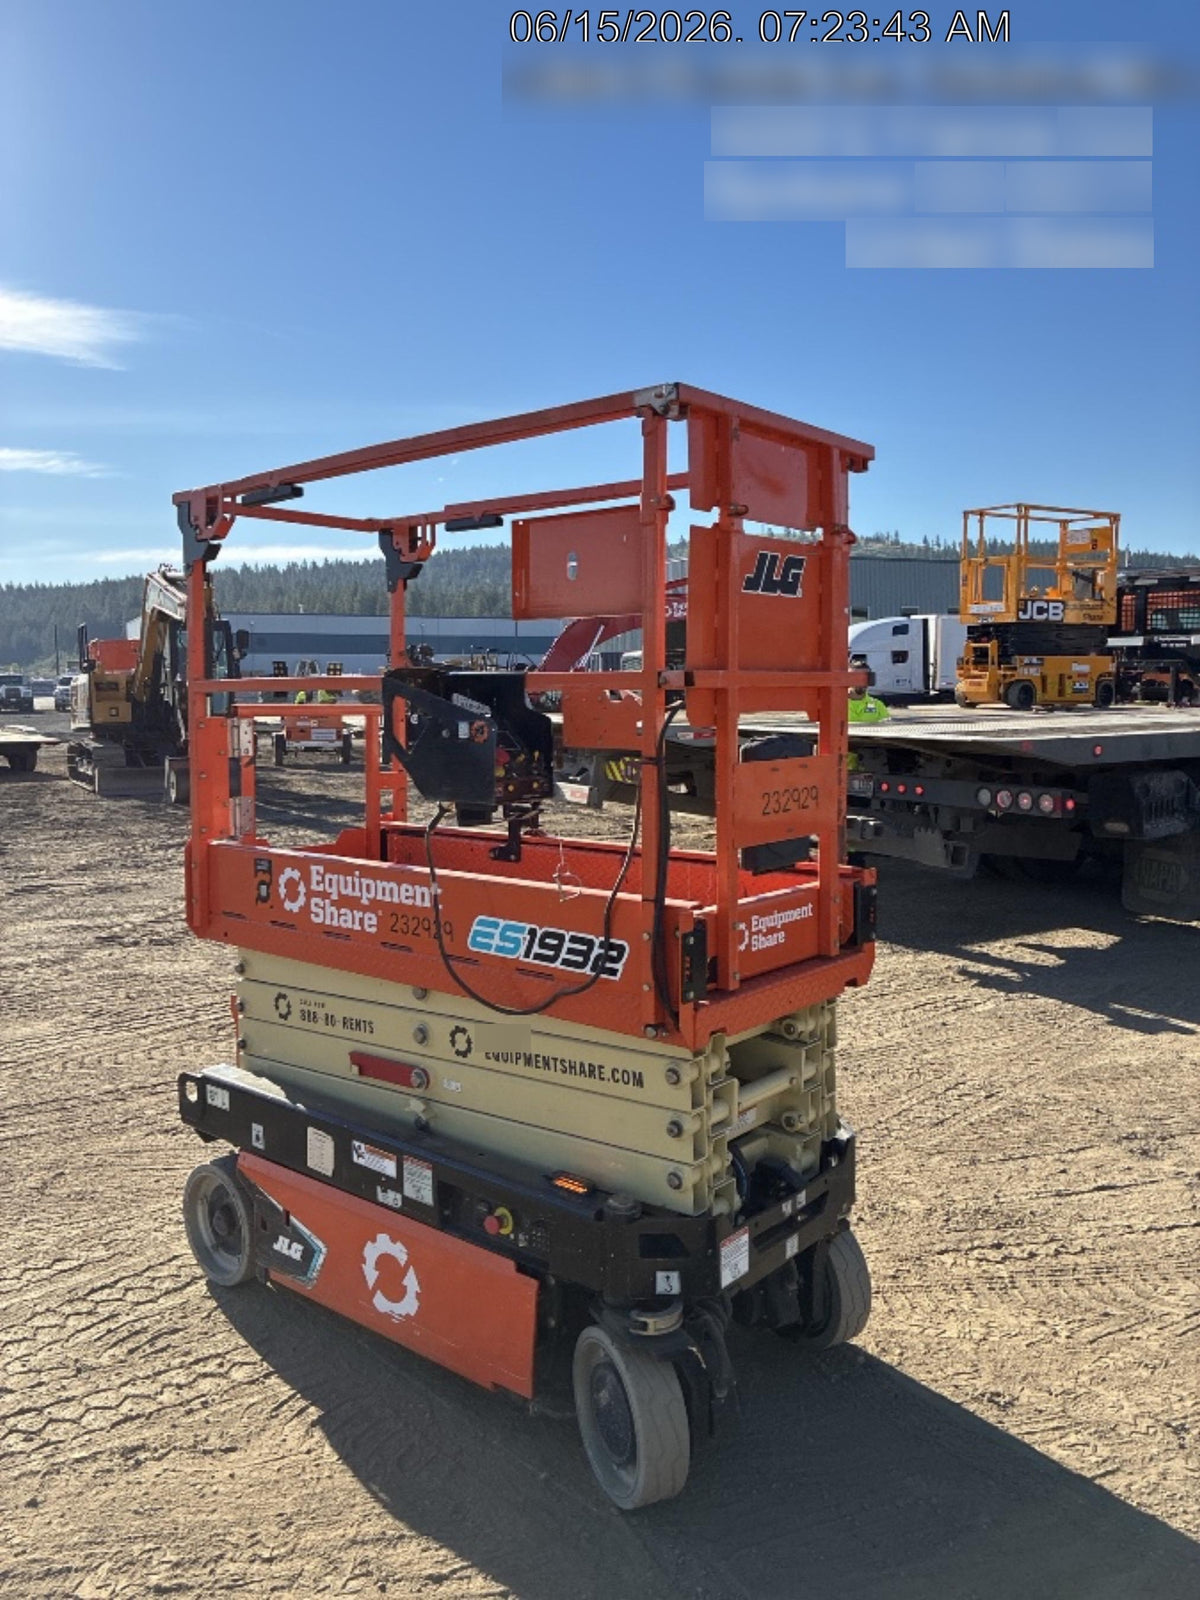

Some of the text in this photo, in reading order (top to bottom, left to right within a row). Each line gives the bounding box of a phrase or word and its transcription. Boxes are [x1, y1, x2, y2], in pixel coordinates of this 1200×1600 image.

[743, 551, 805, 598] JLG
[1018, 600, 1065, 621] JCB
[762, 788, 820, 819] 232929
[310, 865, 442, 910] Equipment
[310, 898, 377, 933] Share
[752, 903, 813, 935] Equipment
[468, 915, 629, 981] ES1932
[751, 924, 785, 946] Share
[484, 1051, 645, 1089] EQUIPMENTSHARE.COM
[273, 1235, 304, 1261] JLG
